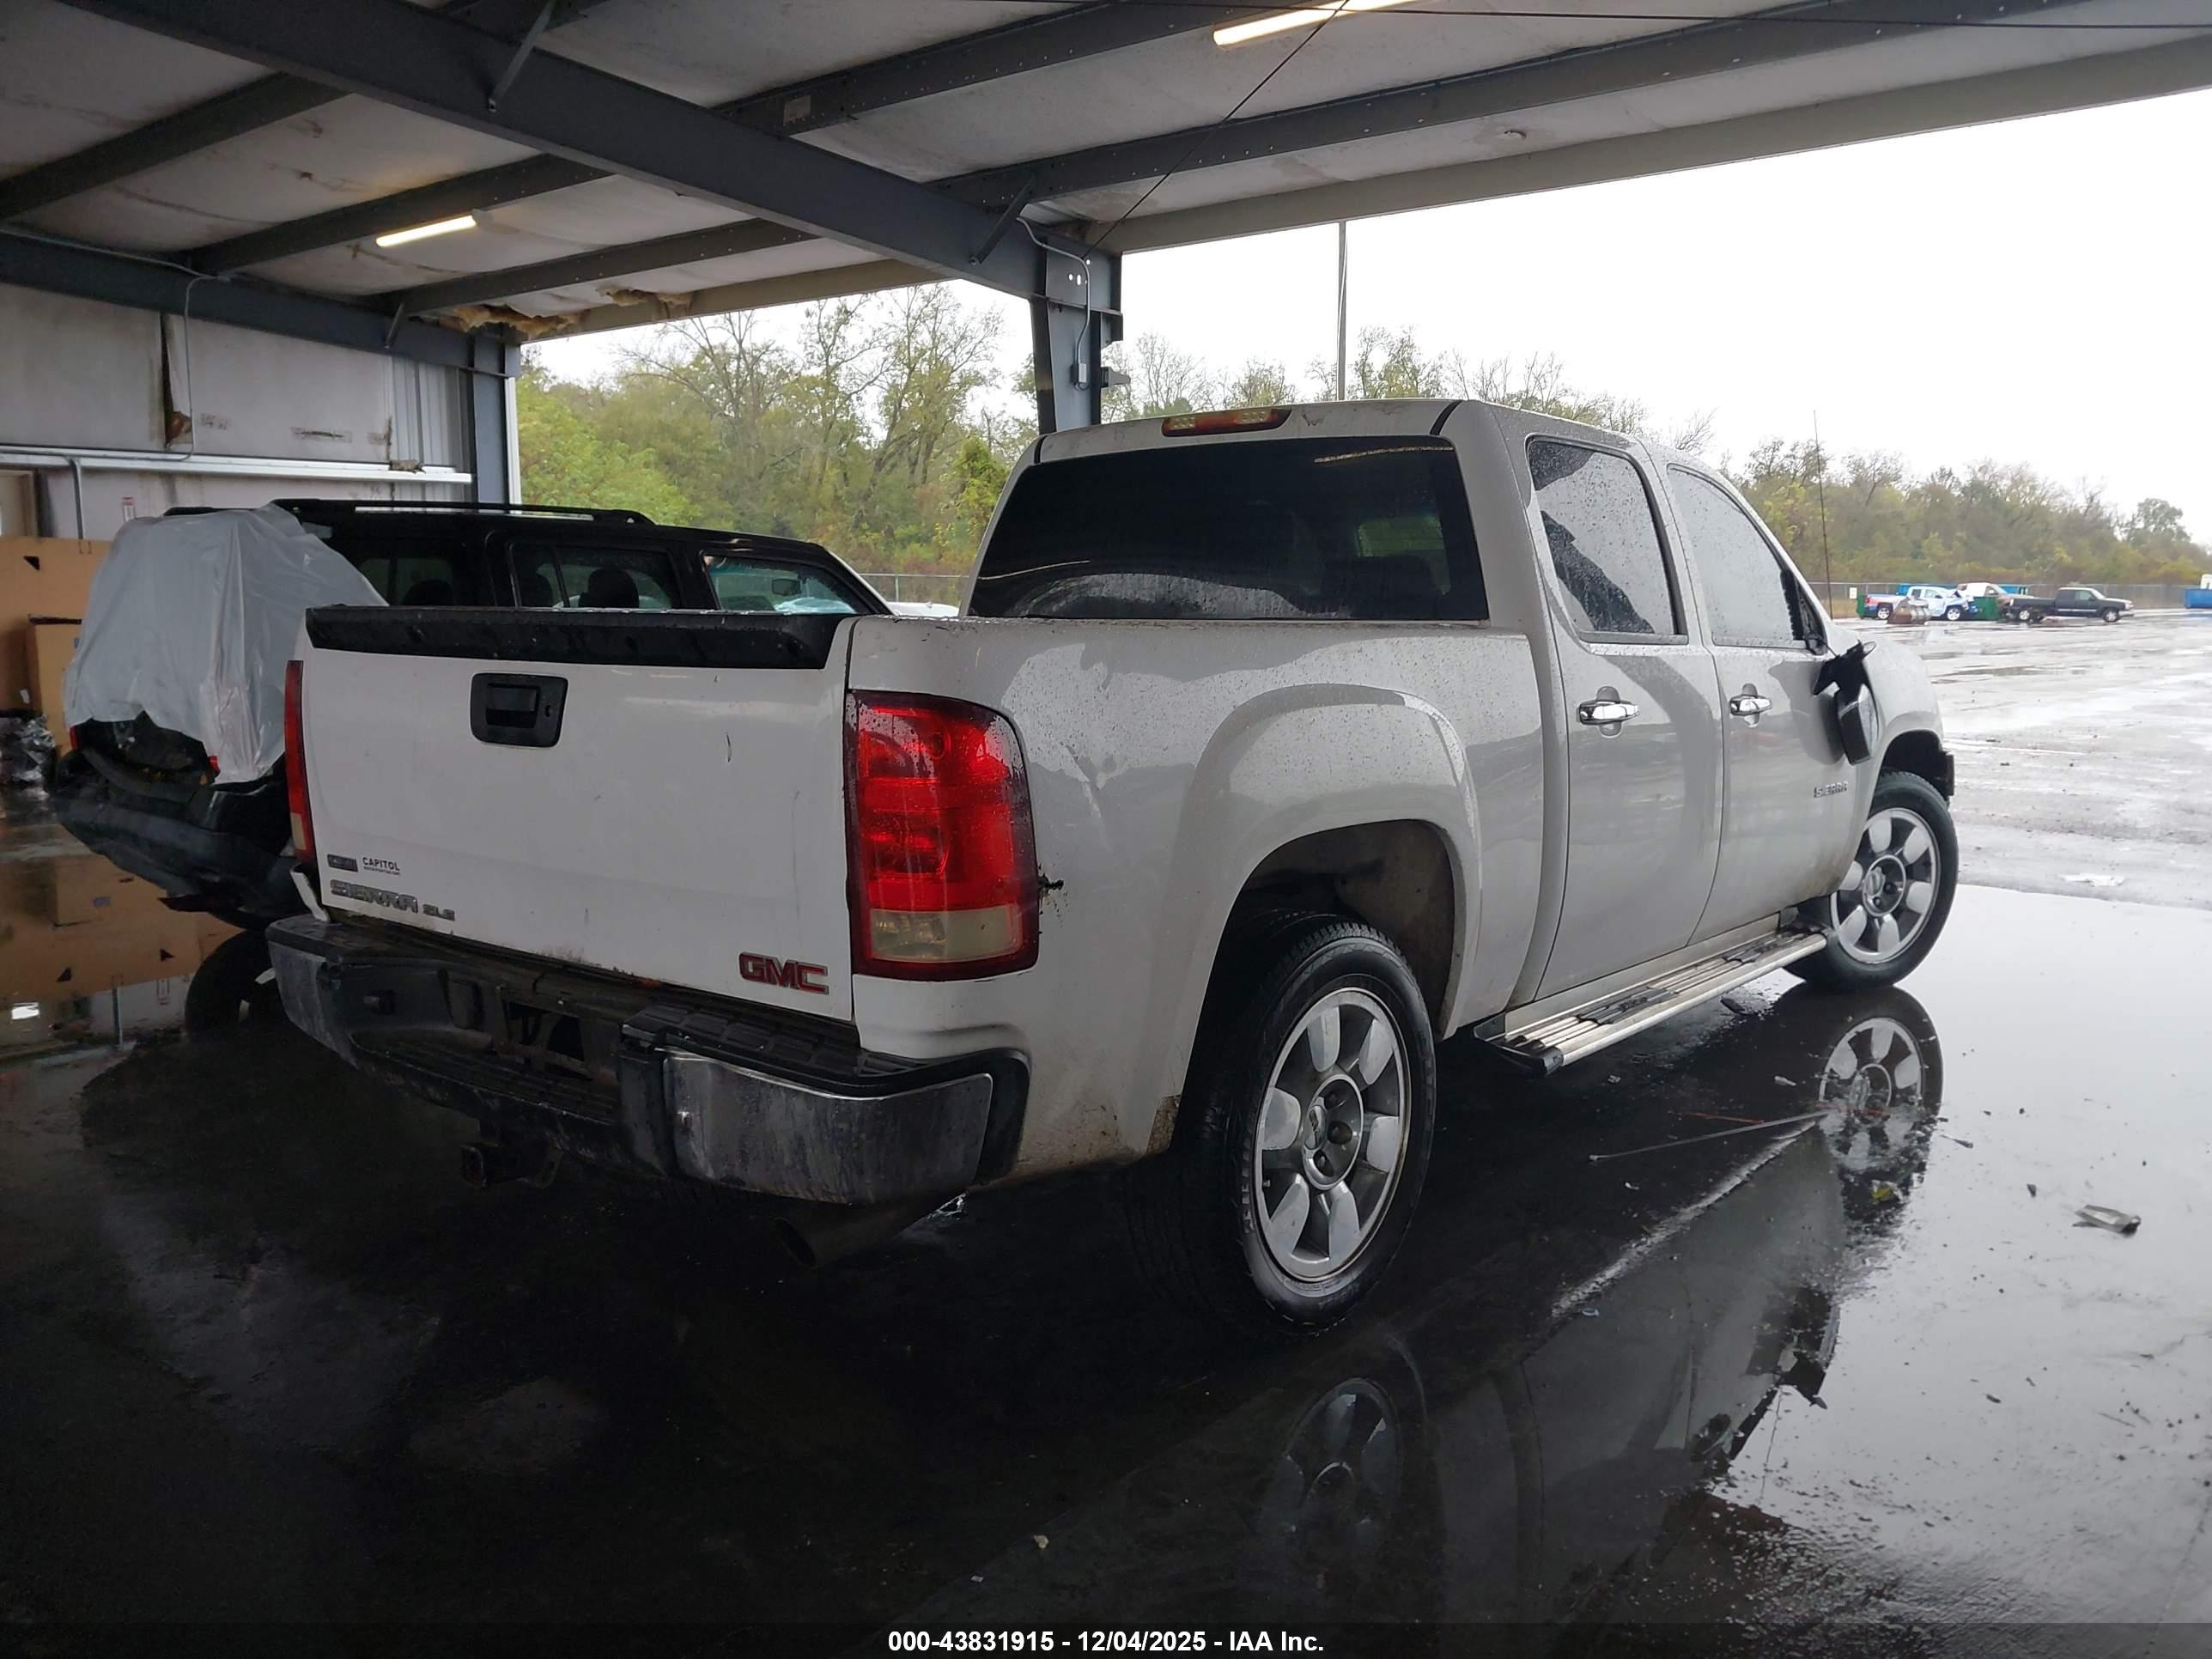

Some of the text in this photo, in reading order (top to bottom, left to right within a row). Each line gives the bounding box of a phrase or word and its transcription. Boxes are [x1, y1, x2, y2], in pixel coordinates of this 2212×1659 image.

[362, 857, 400, 871] CAPITOL
[330, 879, 418, 914] SIERRA
[739, 951, 830, 995] GMC
